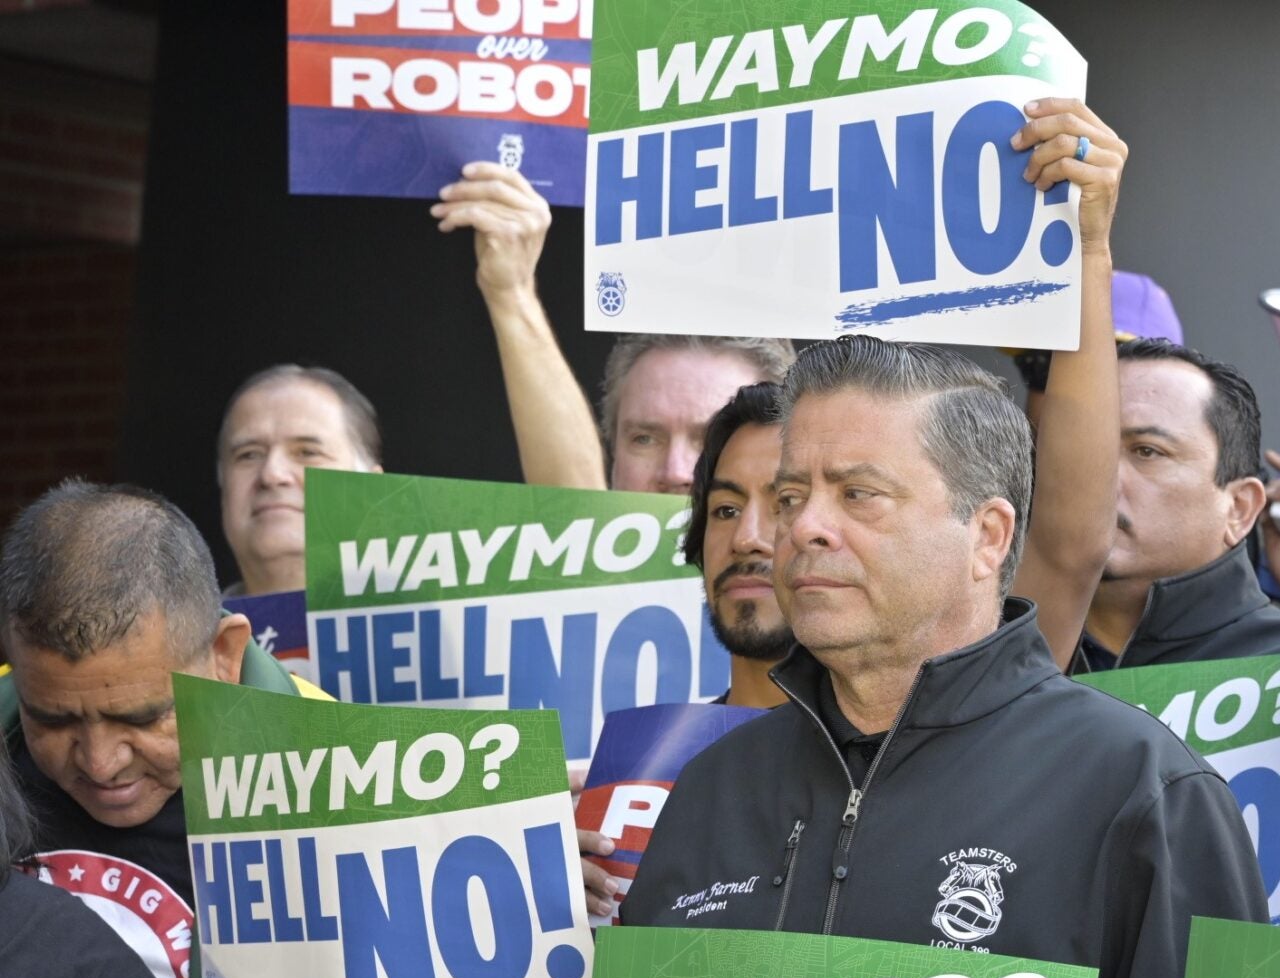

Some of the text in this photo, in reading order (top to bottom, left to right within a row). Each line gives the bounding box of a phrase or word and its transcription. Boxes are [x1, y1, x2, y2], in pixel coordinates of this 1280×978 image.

[476, 35, 548, 61] over
[637, 7, 1048, 112] WAYMO?
[595, 109, 833, 247] HELL
[339, 509, 692, 597] WAYMO?
[315, 605, 504, 704] HELL
[201, 723, 520, 820] WAYMO?
[100, 867, 163, 915] GIG
[191, 836, 339, 945] HELL
[706, 875, 760, 901] Farnell
[939, 847, 1018, 873] TEAMSTERS
[686, 900, 727, 919] President
[930, 939, 966, 952] LOCAL
